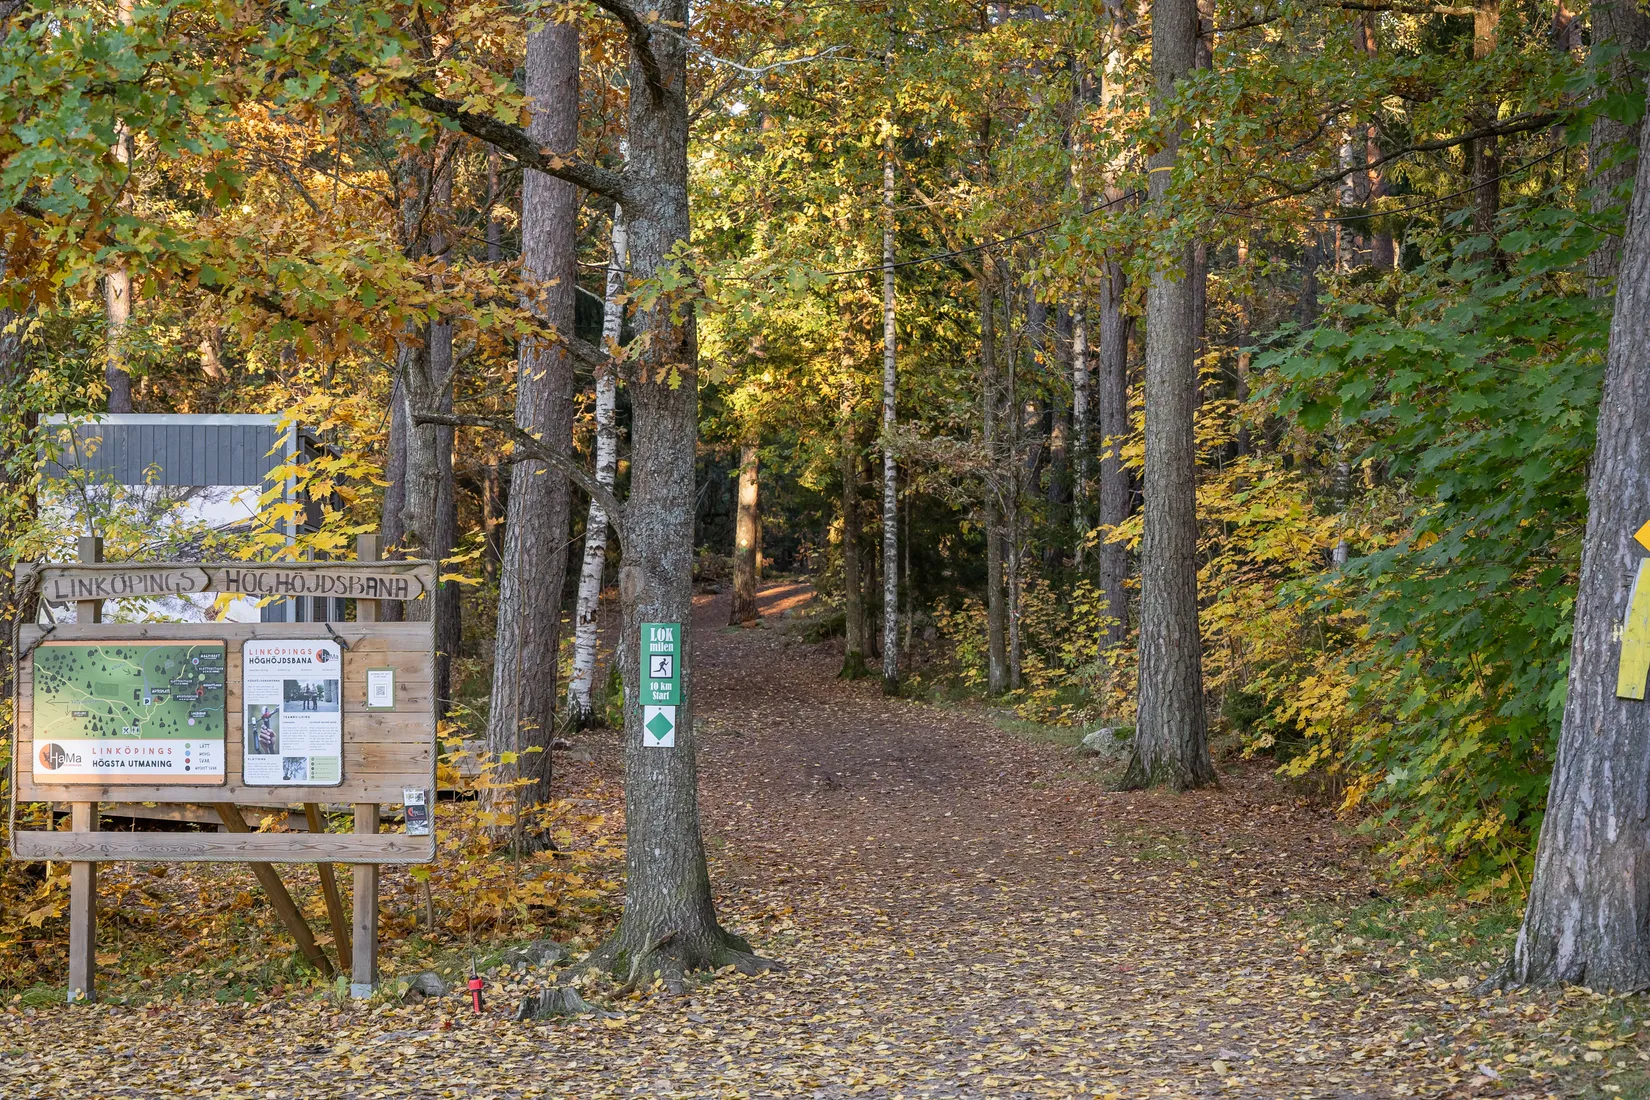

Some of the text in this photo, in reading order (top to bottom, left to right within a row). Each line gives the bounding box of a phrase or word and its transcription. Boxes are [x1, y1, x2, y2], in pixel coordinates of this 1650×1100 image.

[54, 570, 408, 599] LINKÖPINGS HÖGHÖJDSBANA
[650, 627, 674, 642] LOK
[249, 647, 312, 656] LINKÖPINGS
[650, 642, 674, 652] milen
[249, 655, 312, 664] HÖGHÖJDSBANA
[650, 682, 672, 691] 10 km
[652, 691, 670, 700] Start
[92, 745, 173, 755] LINKÖPINGS
[49, 743, 82, 769] HaMa
[92, 759, 126, 768] HÖGSTA
[128, 760, 172, 768] UTMANING
